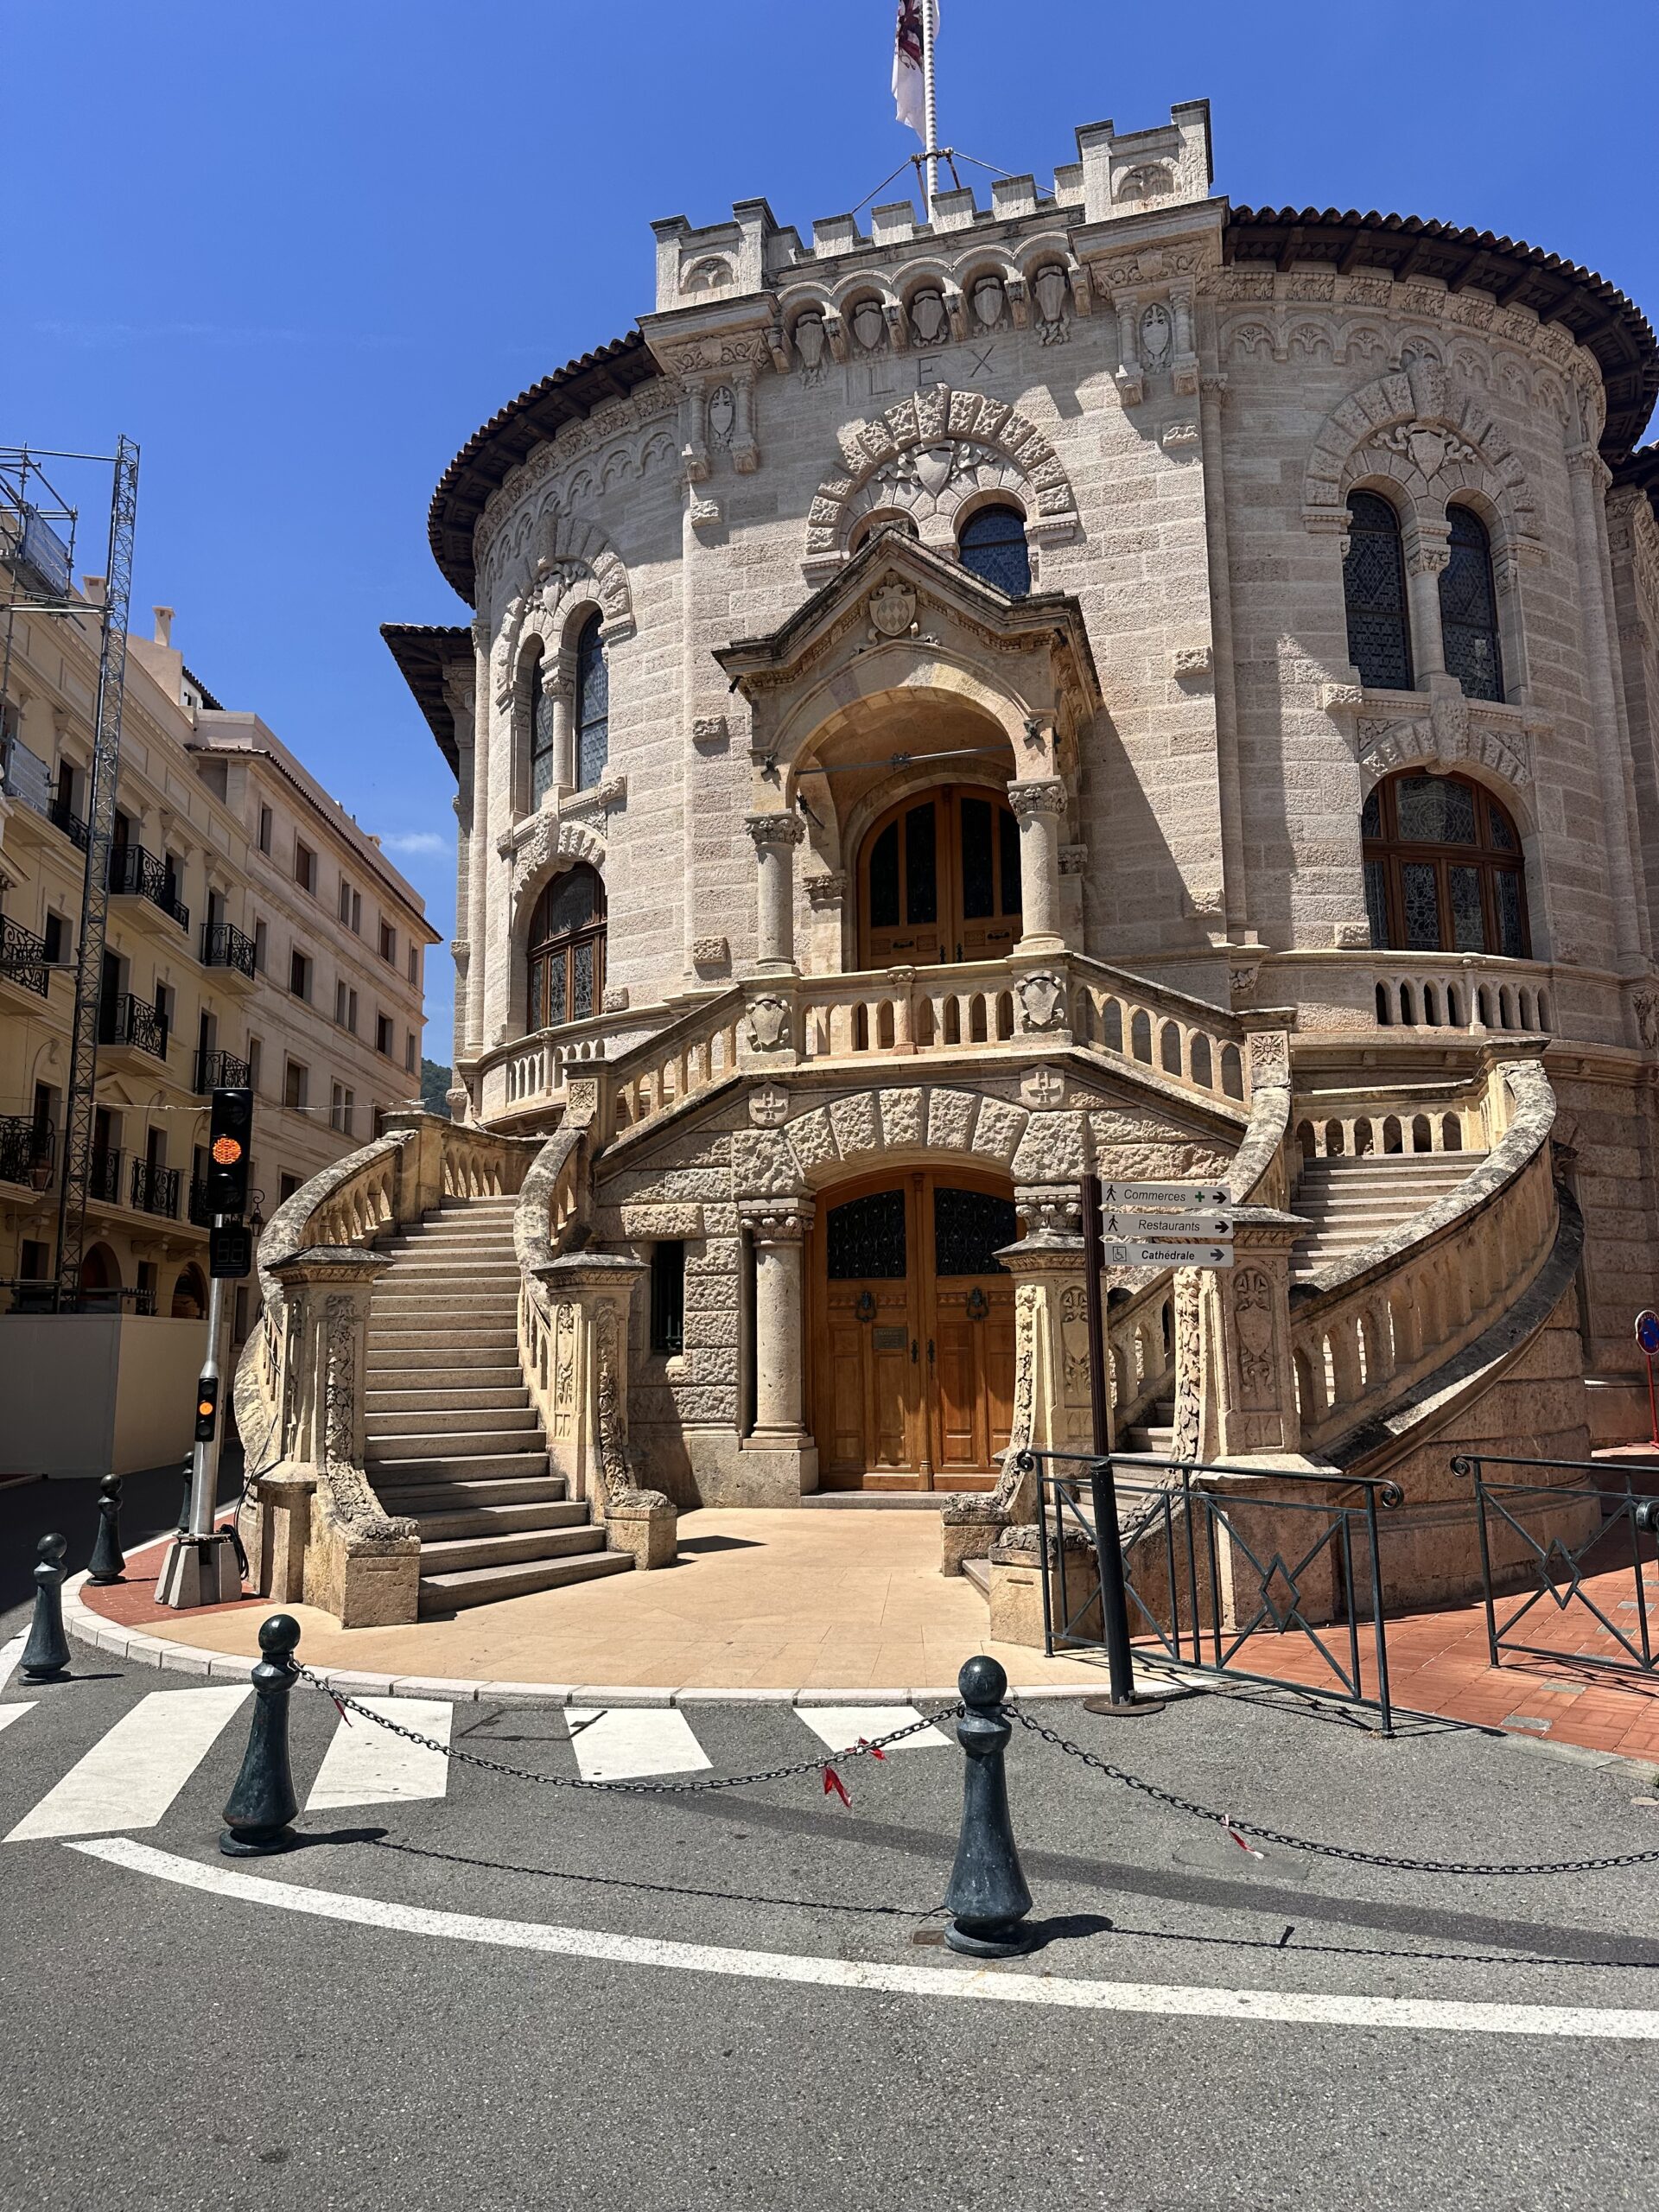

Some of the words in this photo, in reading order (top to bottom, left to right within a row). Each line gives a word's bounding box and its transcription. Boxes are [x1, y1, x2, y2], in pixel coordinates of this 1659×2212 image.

[869, 343, 995, 397] LEX
[1123, 1188, 1186, 1202] Commerces
[1138, 1219, 1200, 1231] Restaurants
[1141, 1249, 1195, 1261] Cathédrale
